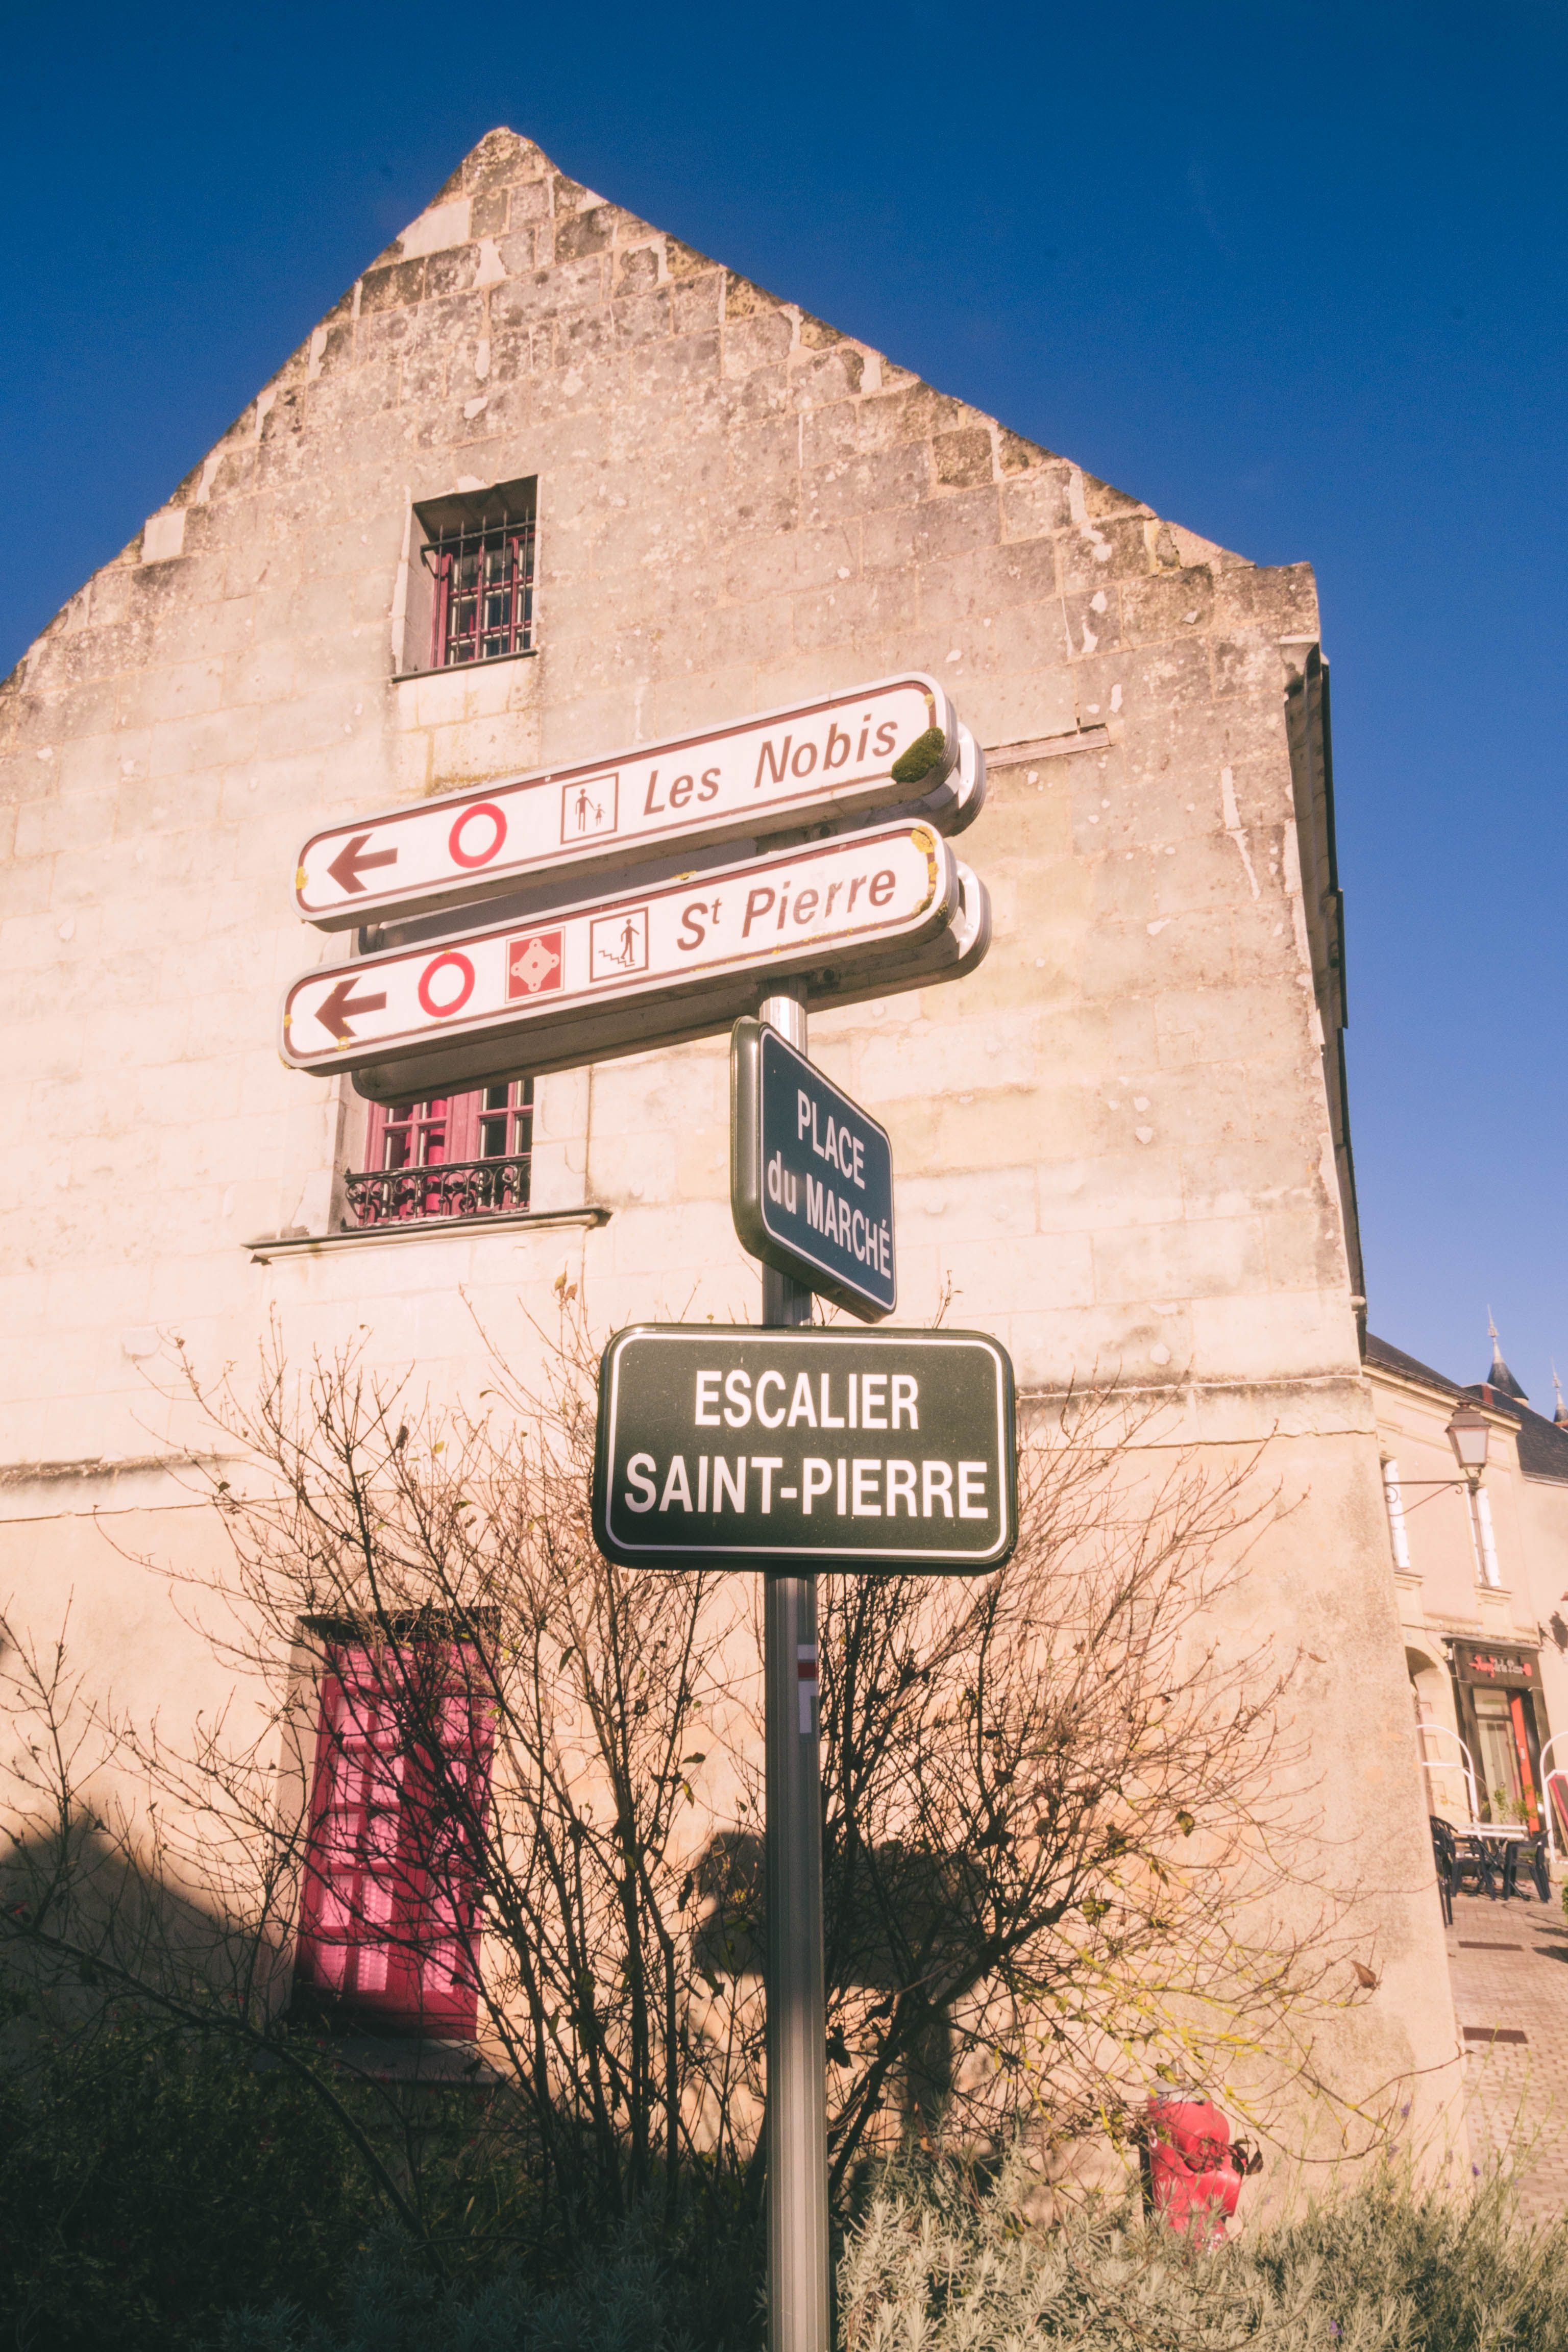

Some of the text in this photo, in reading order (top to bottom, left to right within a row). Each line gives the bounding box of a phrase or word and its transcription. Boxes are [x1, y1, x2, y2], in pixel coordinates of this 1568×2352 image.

[644, 713, 898, 816] Les Nobis
[677, 870, 896, 951] St Pierre
[798, 1089, 865, 1190] PLACE
[767, 1151, 892, 1280] du MARCHÉ
[695, 1369, 919, 1430] ESCALIER
[625, 1453, 989, 1519] SAINT-PIERRE
